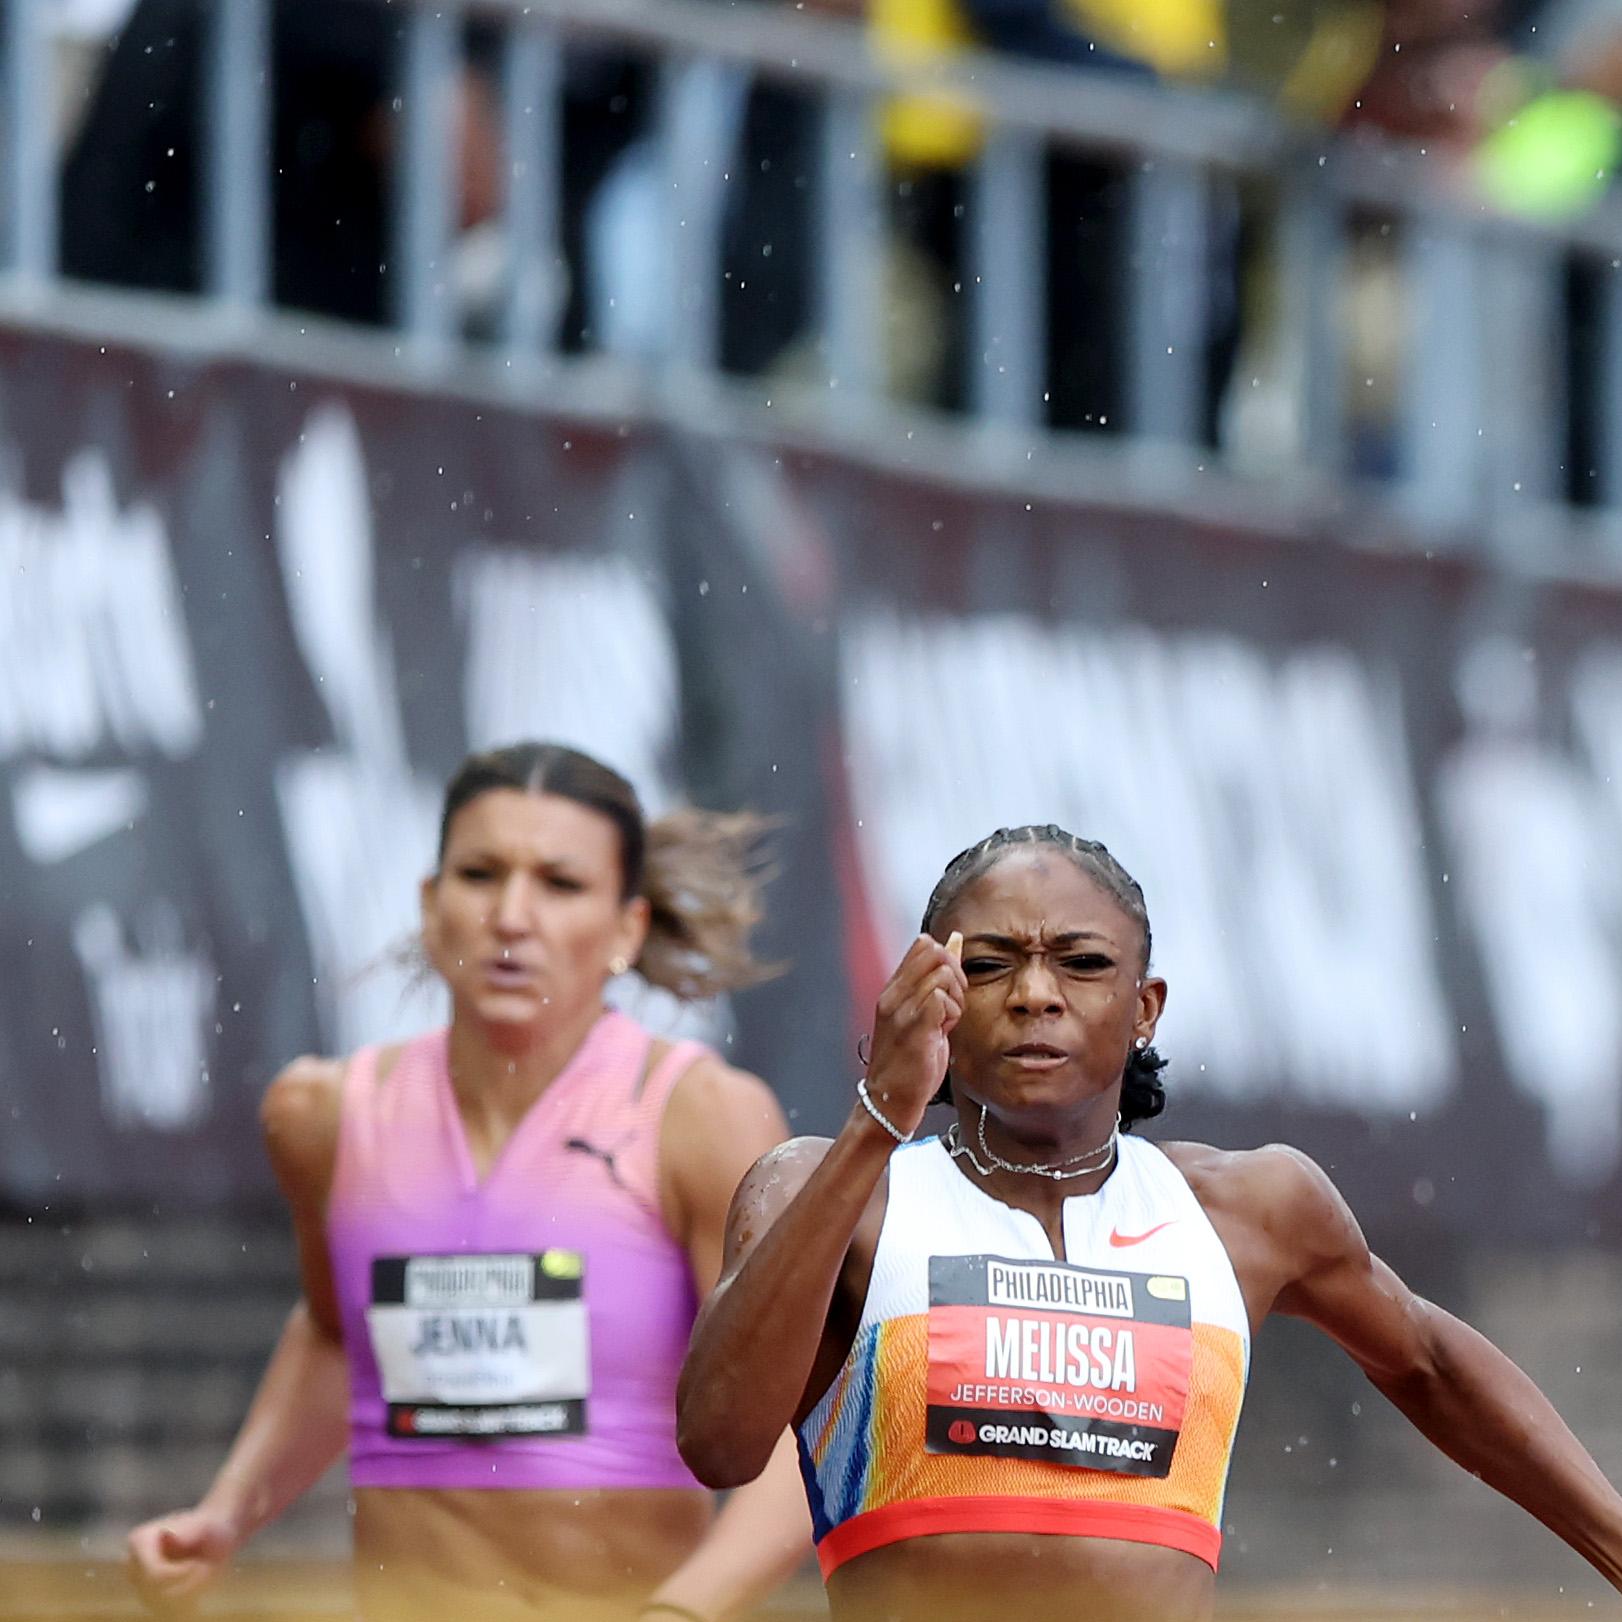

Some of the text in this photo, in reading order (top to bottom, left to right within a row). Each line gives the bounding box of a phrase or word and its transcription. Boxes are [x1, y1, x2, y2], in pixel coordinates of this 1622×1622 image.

[992, 1267, 1130, 1311] PHILADELPHIA
[411, 1317, 529, 1355] JENNA
[985, 1316, 1137, 1393] MELISSA
[950, 1383, 1164, 1423] JEFFERSON-WOODEN
[979, 1423, 1157, 1462] GRAND SLAM TRACK
